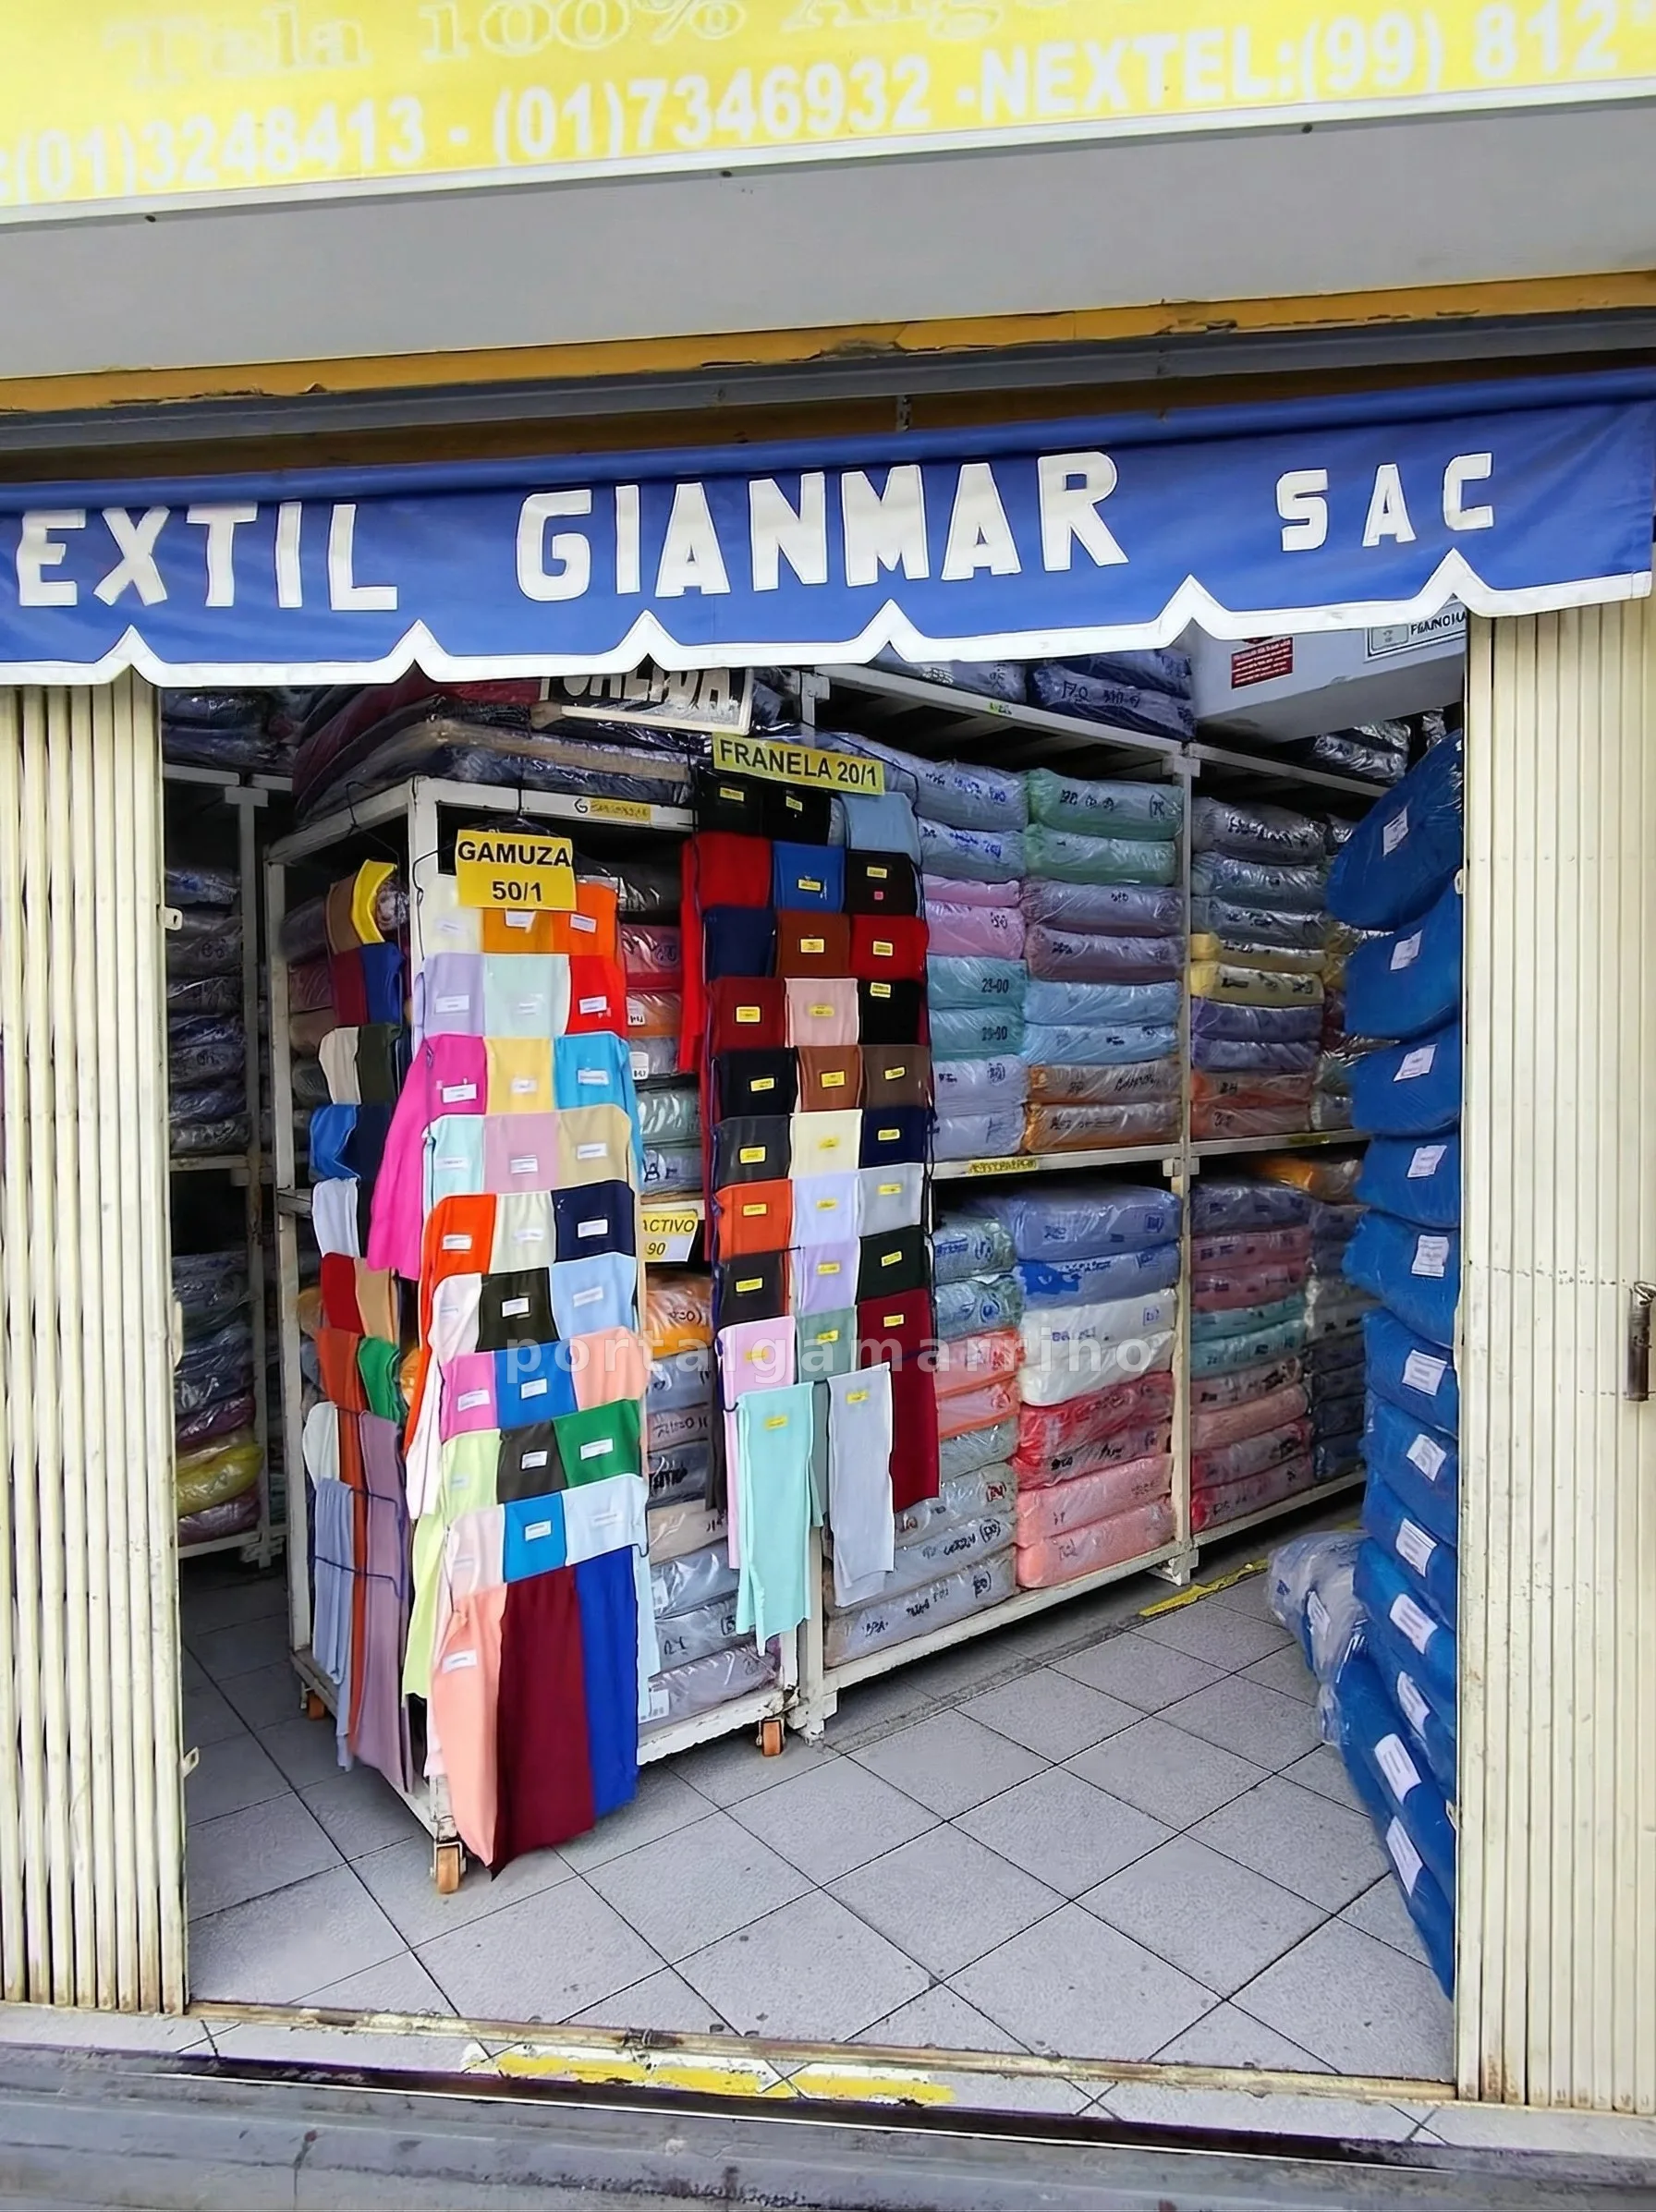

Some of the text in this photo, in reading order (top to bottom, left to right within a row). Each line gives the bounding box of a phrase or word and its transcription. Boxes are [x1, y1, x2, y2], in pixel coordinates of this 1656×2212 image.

[492, 55, 931, 166] (01)7346932
[18, 500, 398, 612] EXTIL
[515, 450, 1129, 603] GIANMAR
[719, 739, 877, 787] FRANELA 20/1
[457, 841, 572, 868] GAMUZA
[492, 881, 542, 903] 50/1
